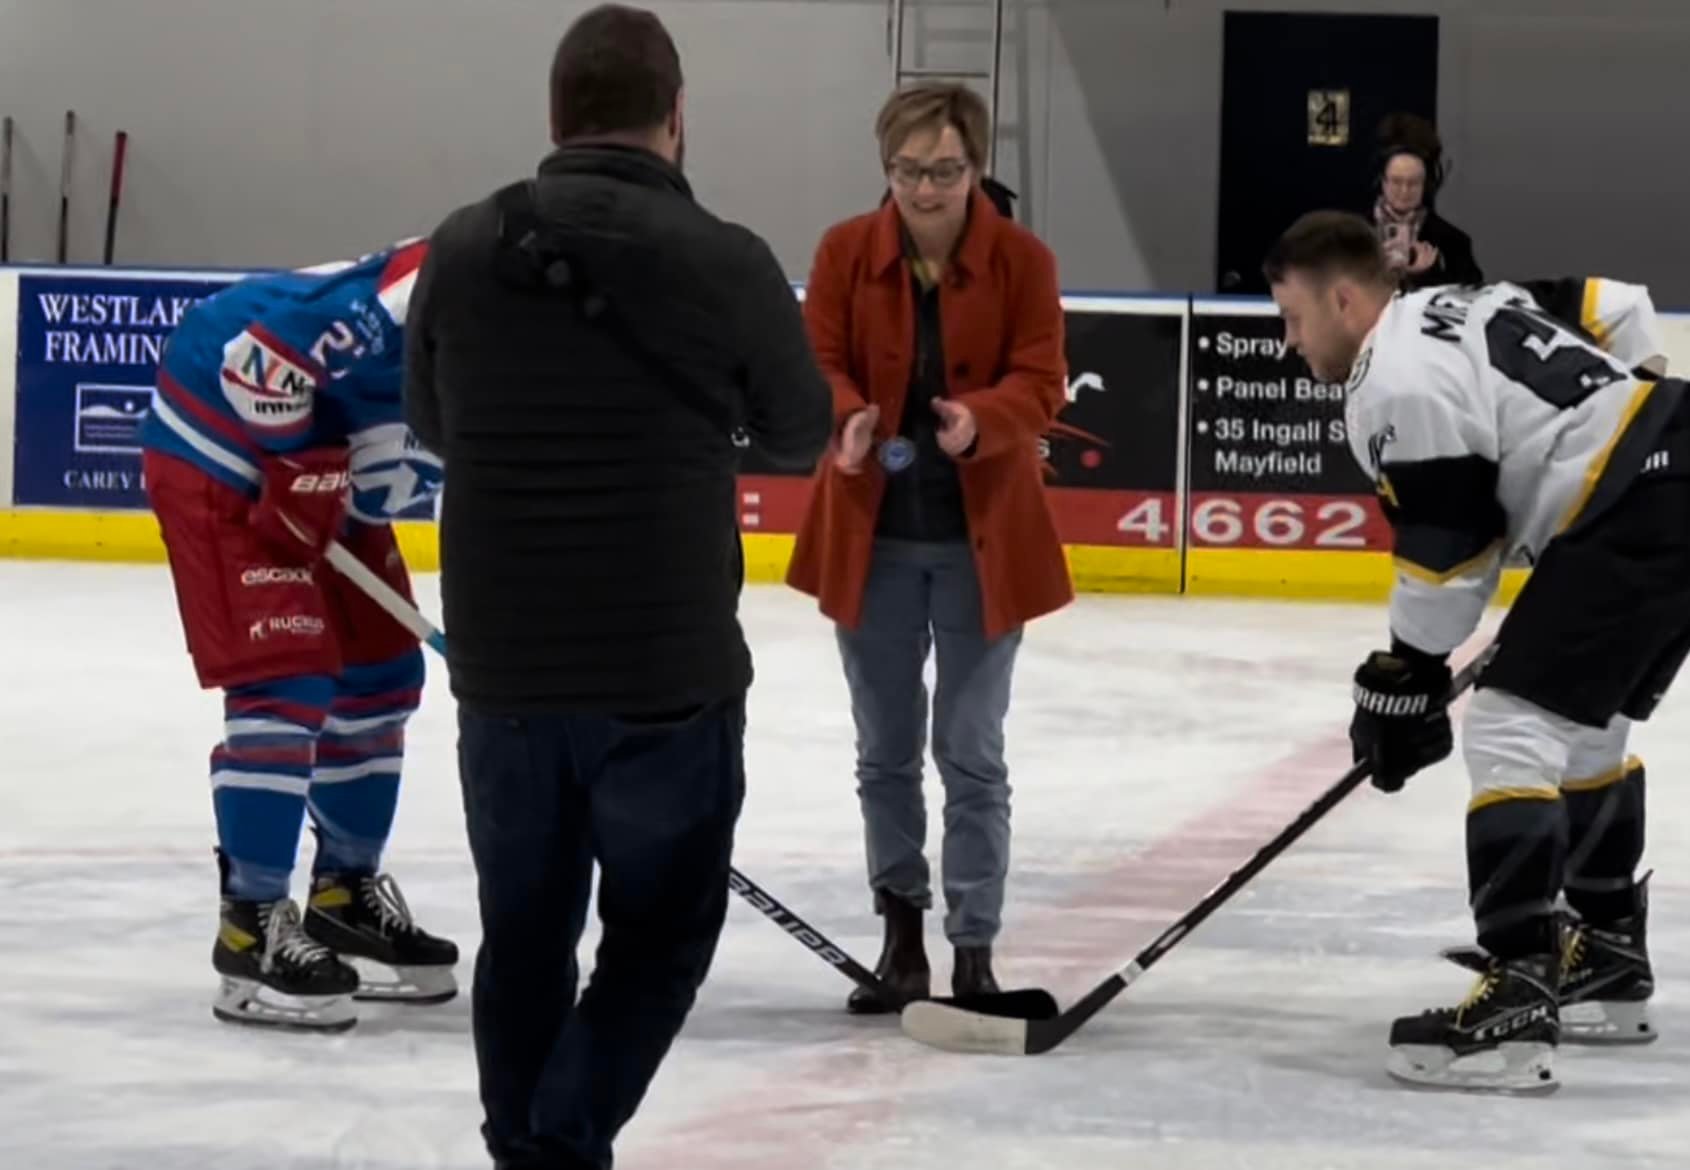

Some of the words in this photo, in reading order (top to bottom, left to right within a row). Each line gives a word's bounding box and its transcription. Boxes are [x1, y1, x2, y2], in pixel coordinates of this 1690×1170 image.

[38, 292, 204, 327] WESTLAK
[44, 330, 168, 366] FRAMIN
[1216, 331, 1287, 359] Spray
[1217, 376, 1287, 399] Panel
[1215, 417, 1245, 440] 35
[1252, 418, 1321, 445] Ingall
[1215, 450, 1322, 478] Mayfield
[63, 470, 133, 490] CAREY
